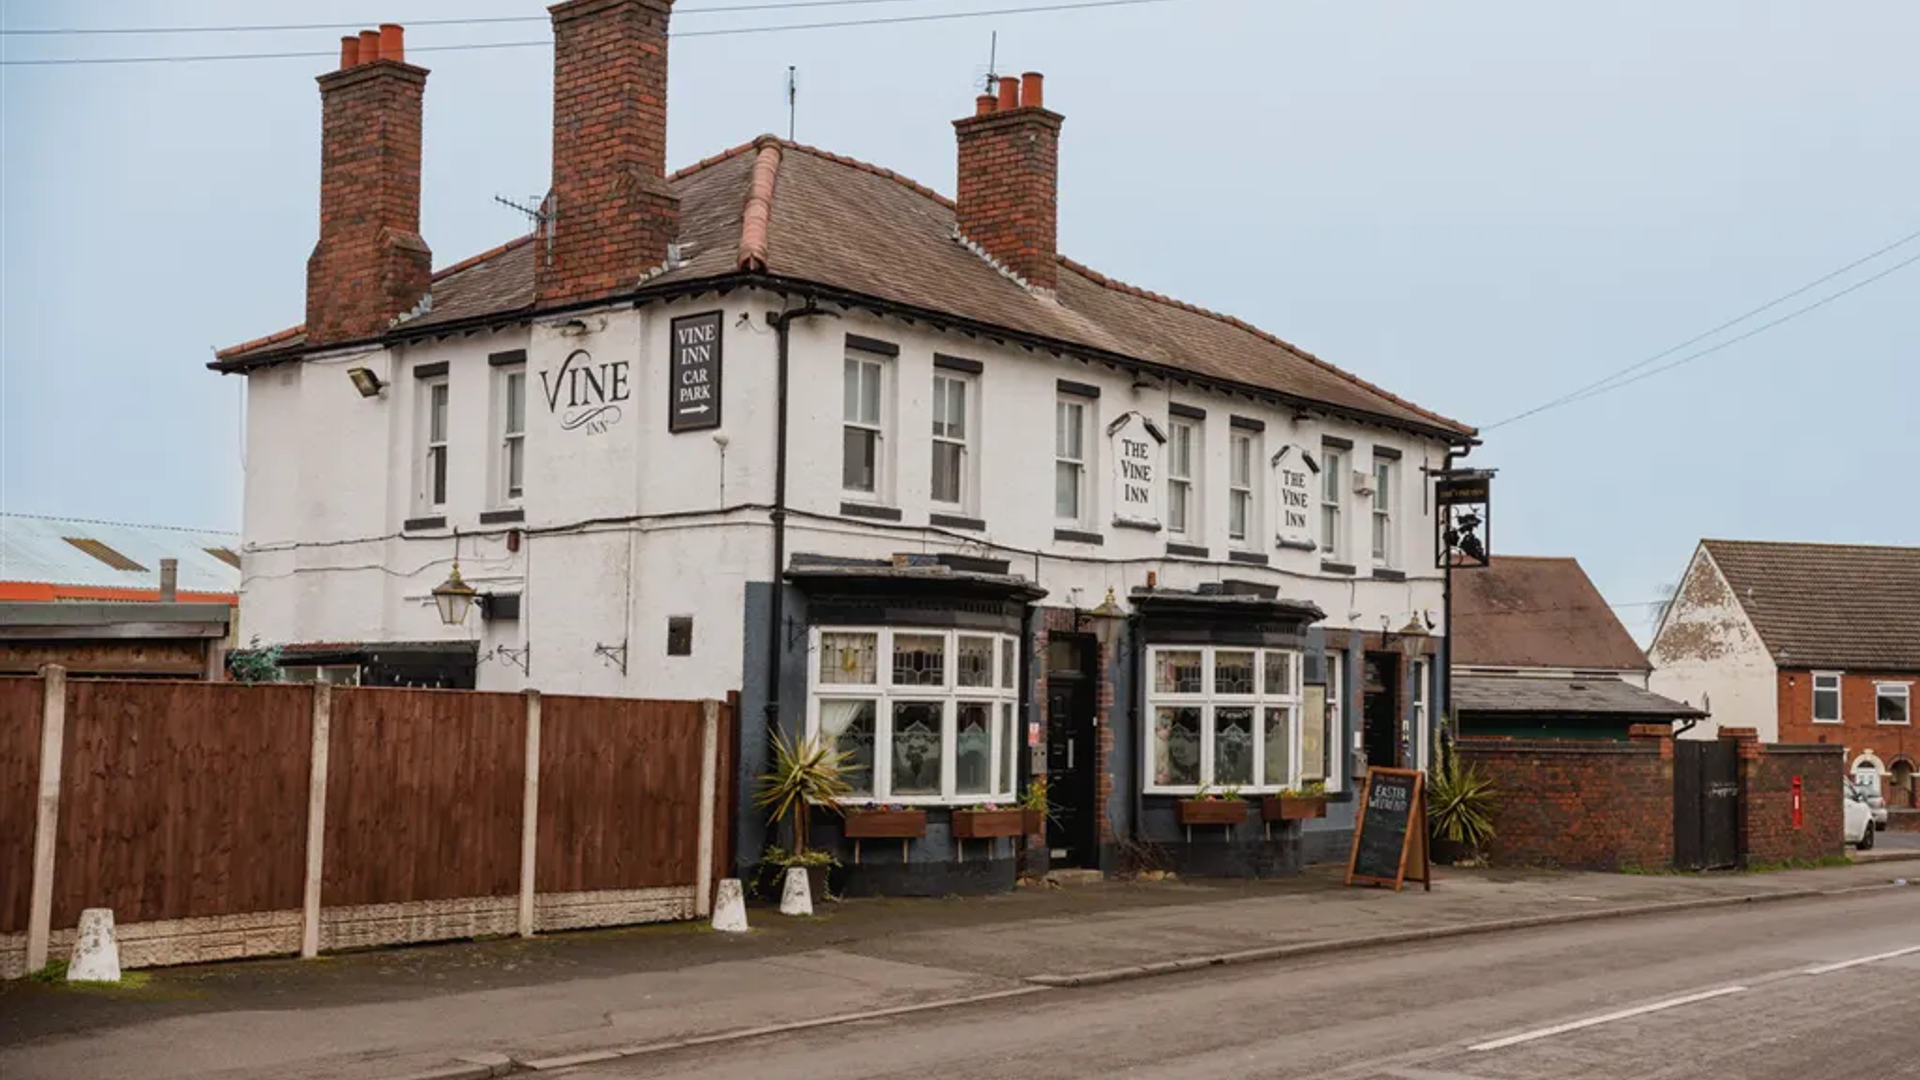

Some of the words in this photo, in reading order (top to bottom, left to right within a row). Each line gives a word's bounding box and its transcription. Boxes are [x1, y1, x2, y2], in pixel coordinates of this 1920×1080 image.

[679, 324, 715, 344] VINE
[681, 345, 710, 364] INN
[539, 349, 630, 413] VINE
[682, 368, 708, 385] CAR
[680, 384, 710, 402] PARK
[586, 419, 609, 436] INN
[1122, 439, 1148, 460] THE
[1121, 460, 1151, 482] VINE
[1282, 469, 1306, 488] THE
[1125, 484, 1148, 503] INN
[1282, 488, 1308, 508] VINE
[1285, 510, 1306, 527] INN
